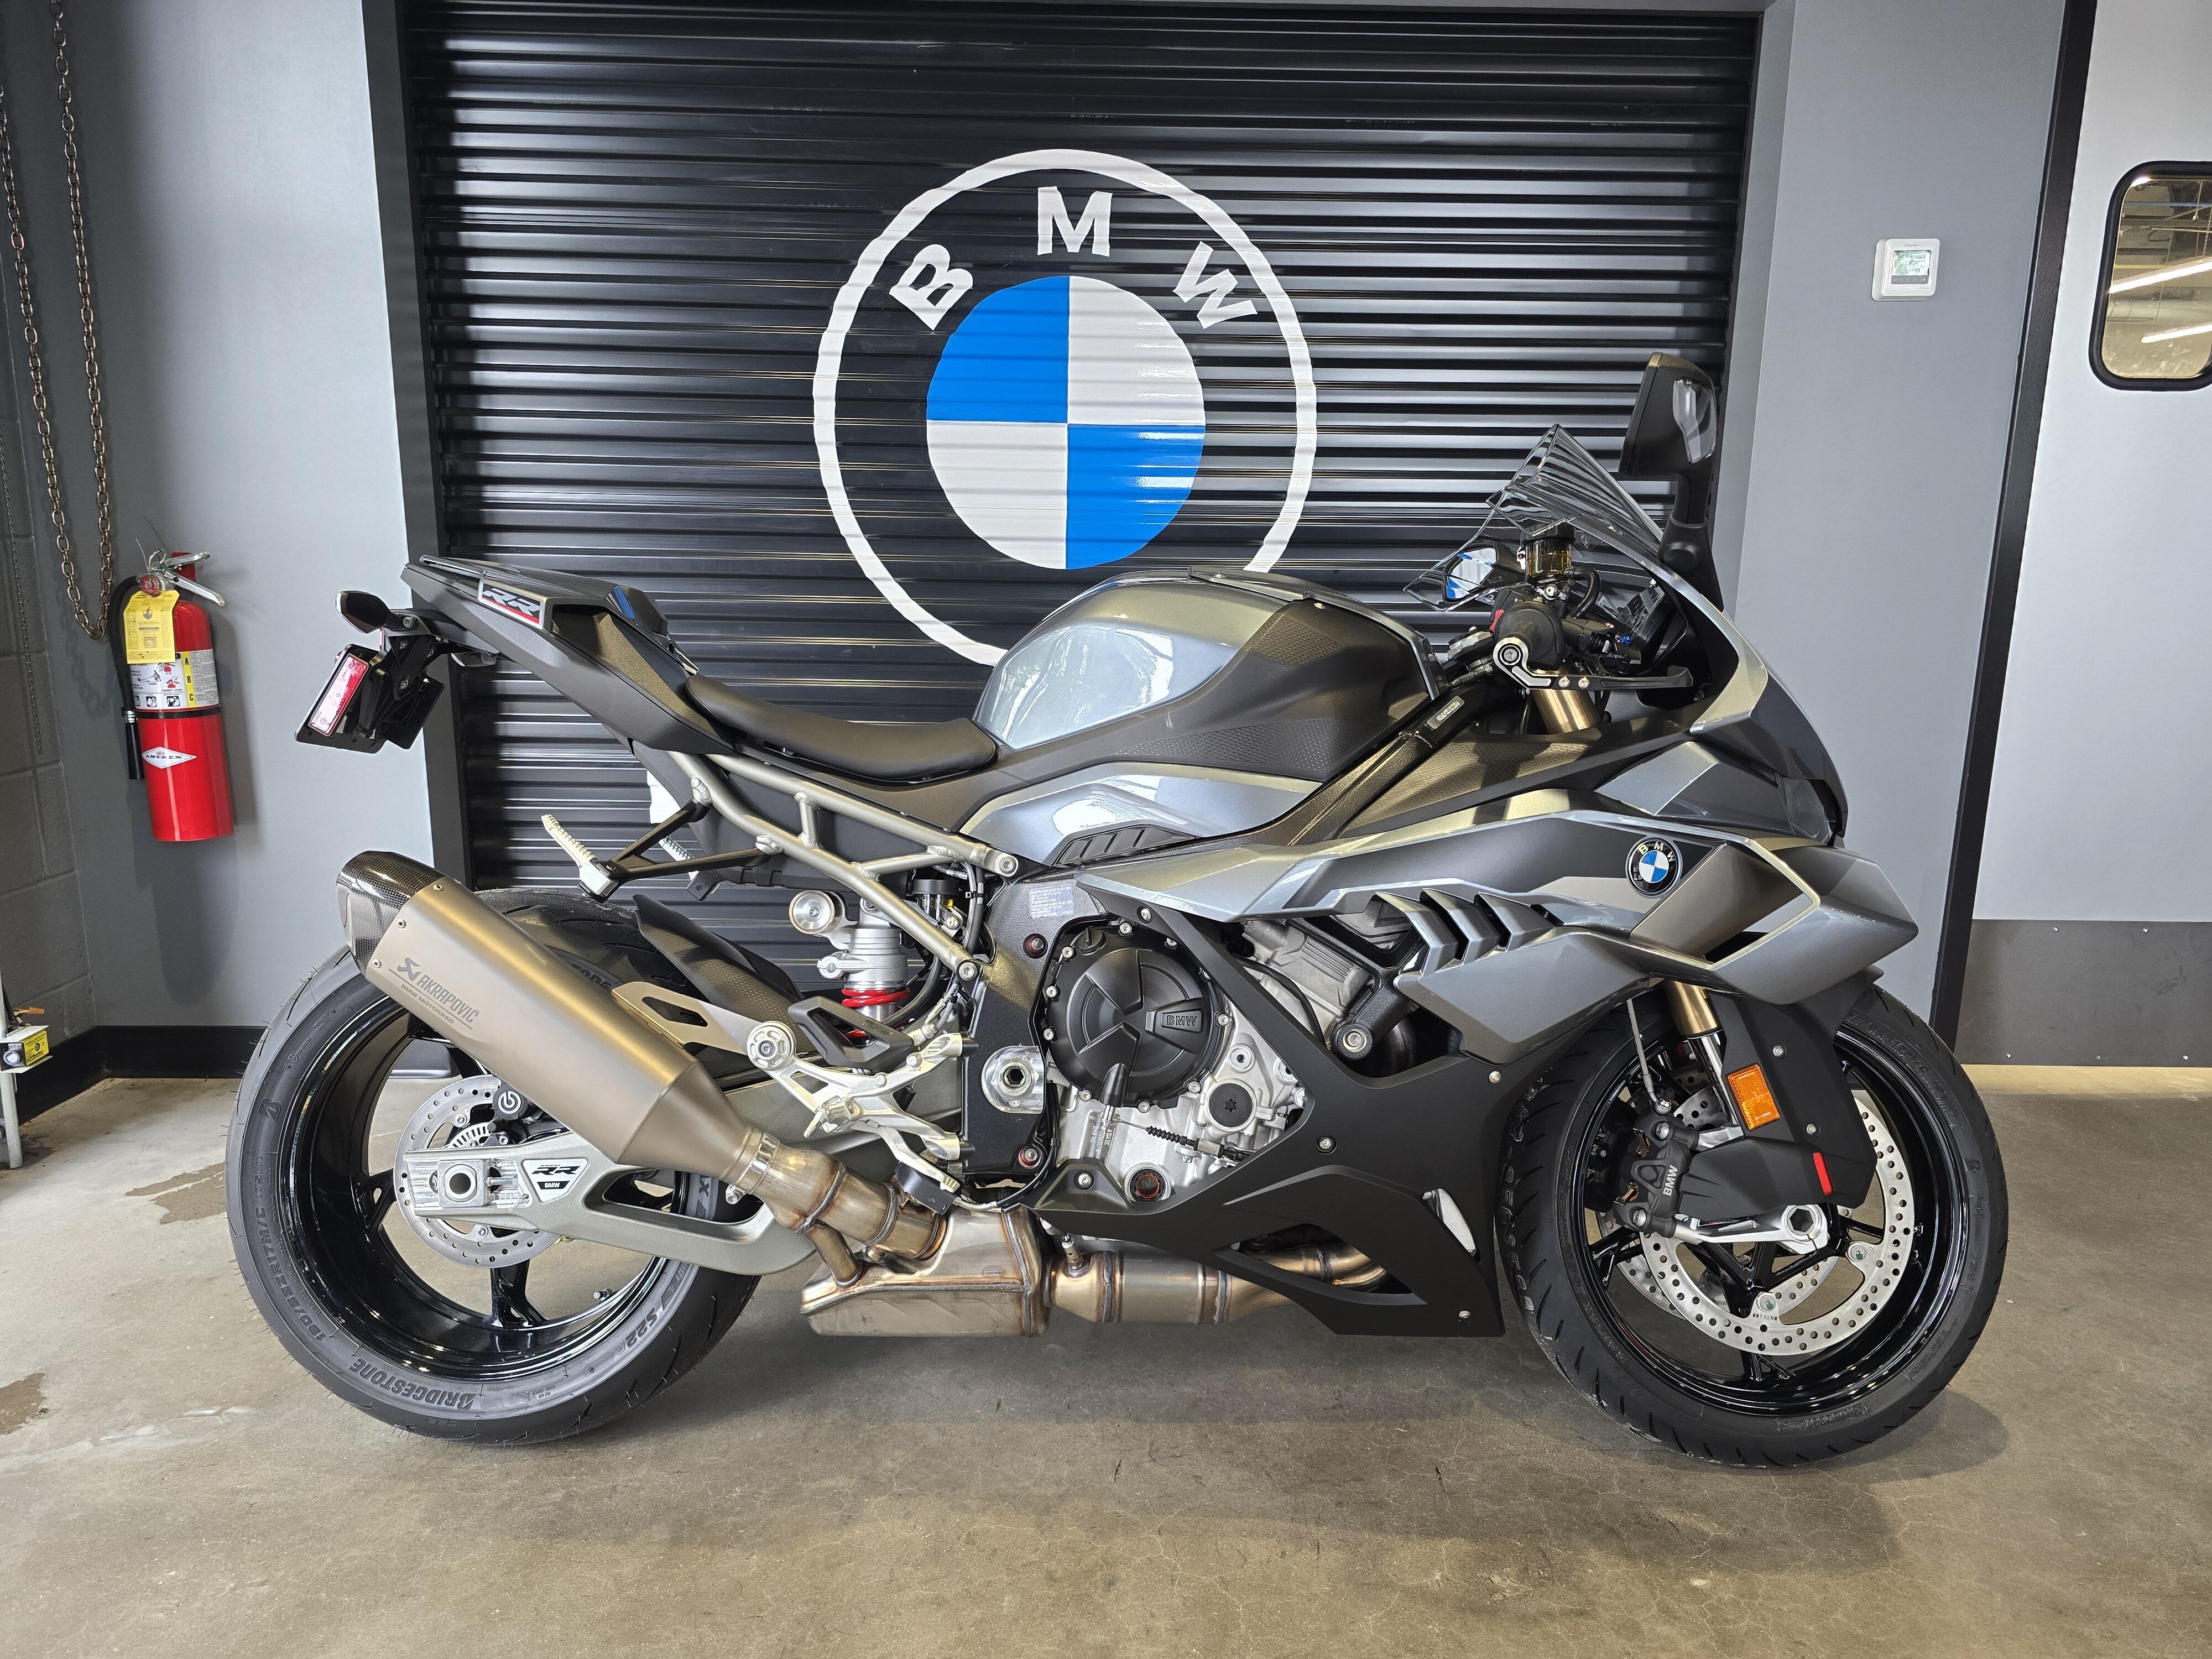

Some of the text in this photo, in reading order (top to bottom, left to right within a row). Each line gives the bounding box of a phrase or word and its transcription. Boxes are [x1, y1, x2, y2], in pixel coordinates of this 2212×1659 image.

[890, 186, 1258, 331] BMW
[482, 588, 540, 617] RR
[1638, 841, 1676, 862] BMW
[401, 984, 418, 997] BMW
[418, 997, 454, 1024] MOTORRAD
[1166, 1015, 1197, 1026] BMW
[531, 1166, 581, 1176] RR
[1662, 1165, 1678, 1196] BMW
[348, 1358, 477, 1410] BRIDGESTONE
